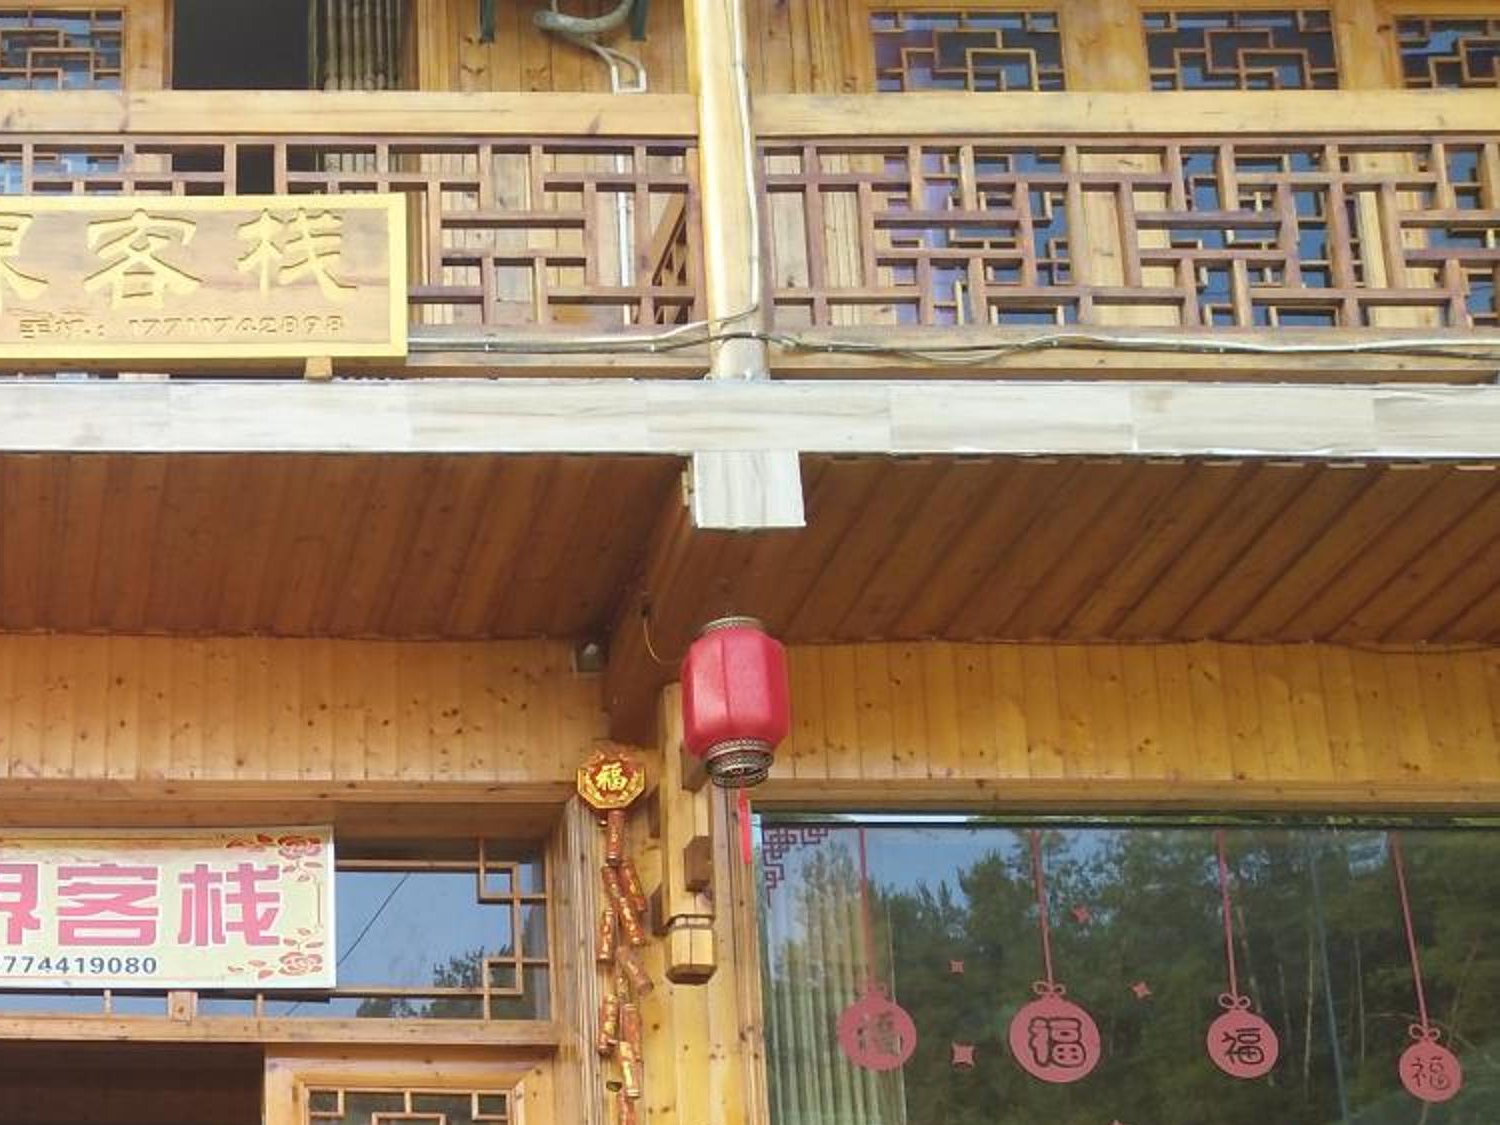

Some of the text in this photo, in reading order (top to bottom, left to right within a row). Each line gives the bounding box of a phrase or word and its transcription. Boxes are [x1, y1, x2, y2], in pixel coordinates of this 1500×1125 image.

[595, 761, 628, 791] 福
[1027, 1016, 1087, 1068] 福
[1221, 1026, 1265, 1065] 福
[1411, 1055, 1452, 1091] 福
